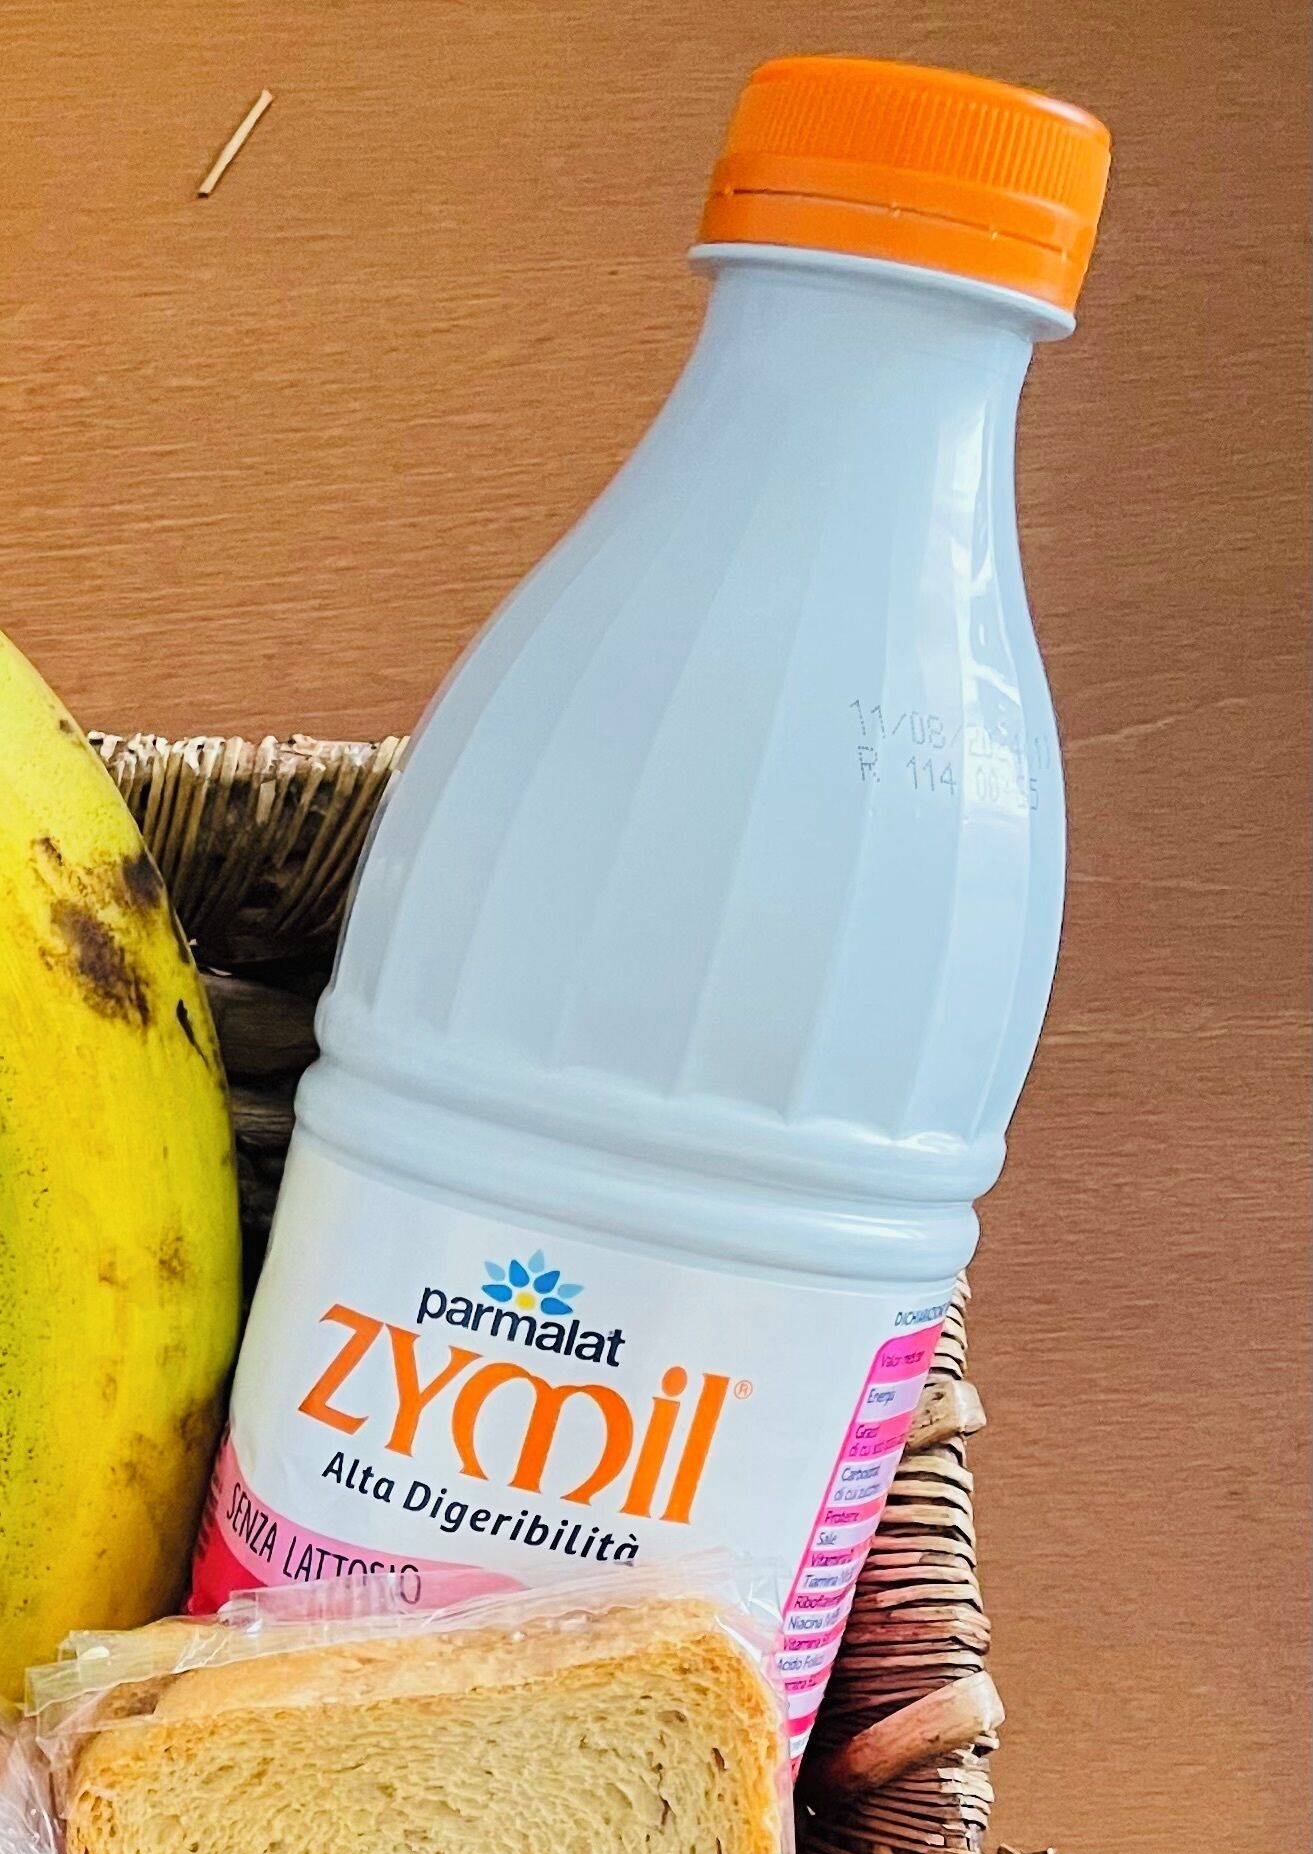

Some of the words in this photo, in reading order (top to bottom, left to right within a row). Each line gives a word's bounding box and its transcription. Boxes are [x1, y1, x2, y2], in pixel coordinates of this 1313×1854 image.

[906, 755, 957, 795] 114
[417, 1286, 626, 1368] parmalat
[226, 1483, 278, 1563] SENZA
[322, 1451, 391, 1503] Alta
[403, 1481, 640, 1567] Digeribilità
